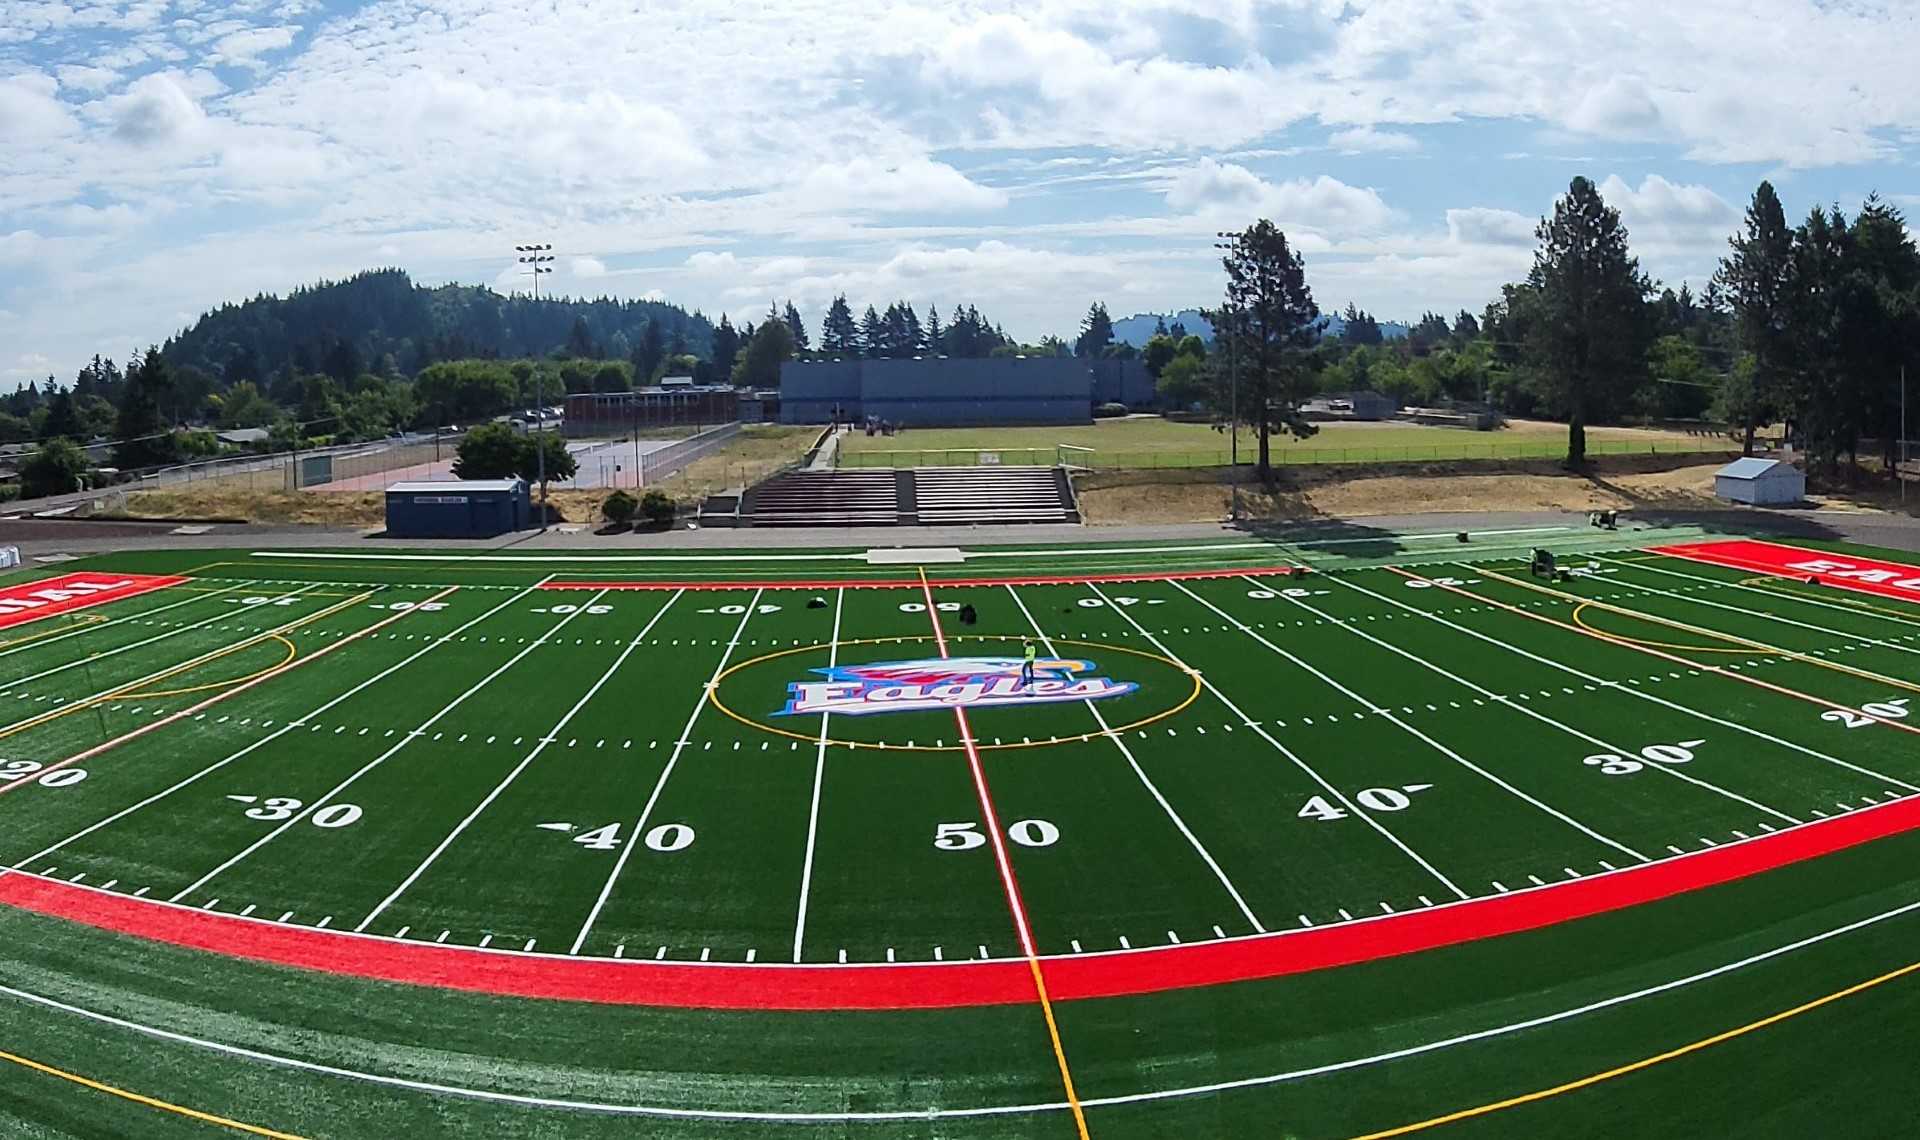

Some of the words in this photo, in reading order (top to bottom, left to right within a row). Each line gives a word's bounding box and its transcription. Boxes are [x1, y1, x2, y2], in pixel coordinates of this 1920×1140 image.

[1784, 559, 1920, 590] EA
[0, 581, 134, 614] IAL
[719, 604, 782, 614] 40
[899, 602, 961, 612] 50
[1077, 597, 1140, 607] 40
[790, 674, 1128, 714] Eagles
[1820, 702, 1909, 728] 20
[0, 758, 88, 787] 20
[1583, 745, 1694, 775] 30
[245, 797, 363, 828] 30
[1297, 788, 1410, 821] 40
[572, 822, 696, 851] 40
[933, 819, 1060, 850] 50
